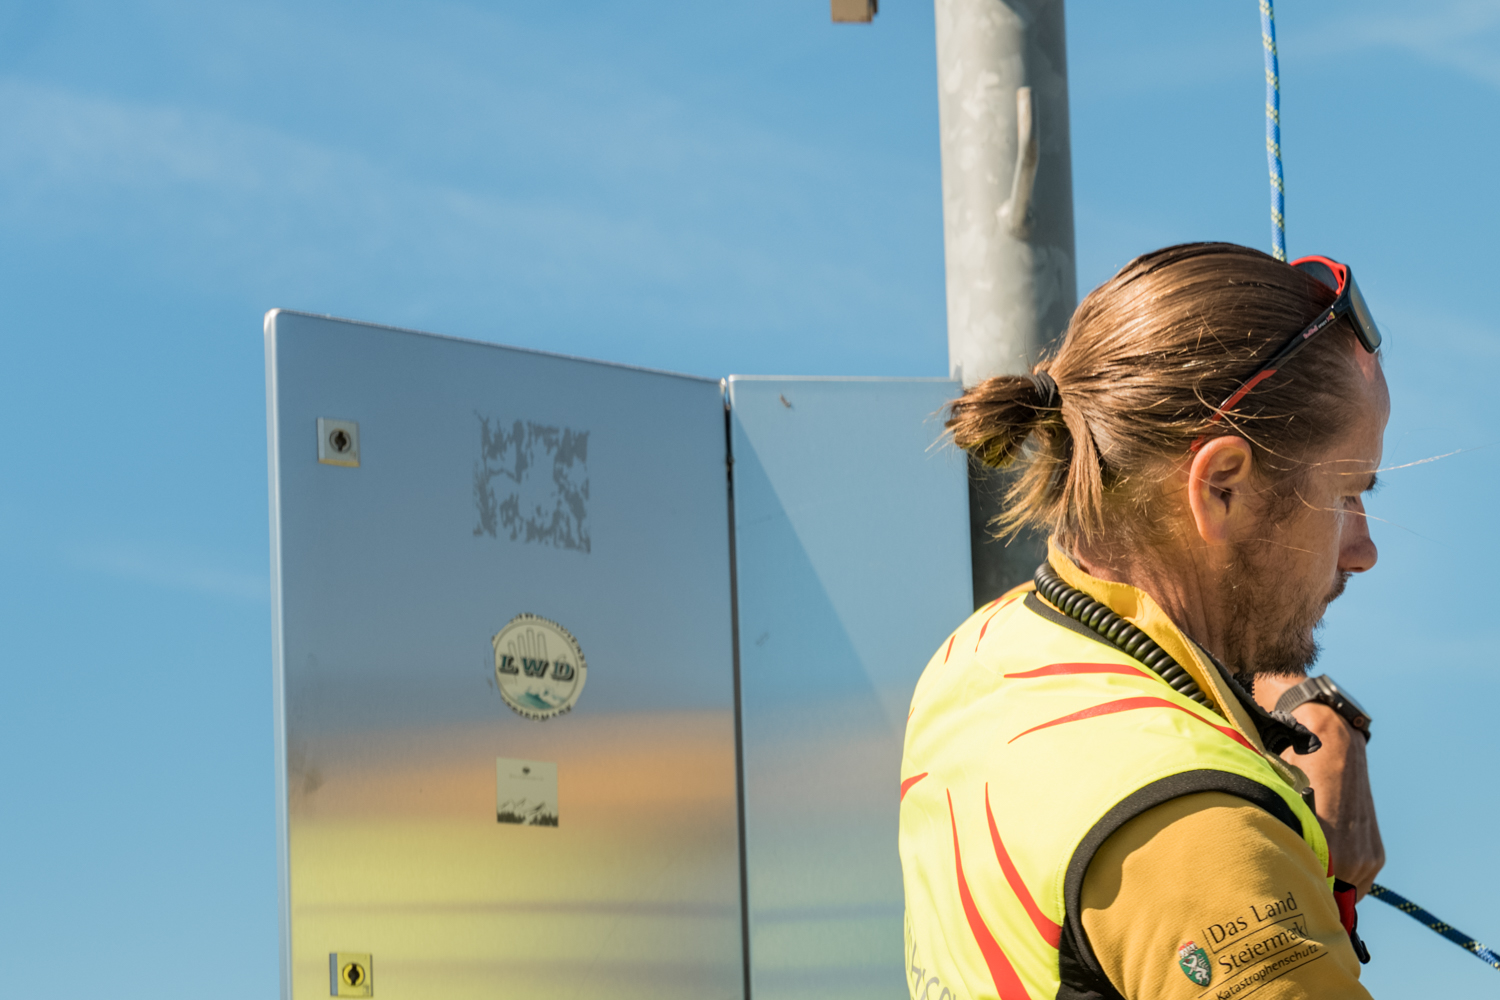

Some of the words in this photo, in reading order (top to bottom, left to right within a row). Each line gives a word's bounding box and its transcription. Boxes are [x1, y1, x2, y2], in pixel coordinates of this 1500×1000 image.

[498, 654, 575, 682] LWD
[1208, 916, 1248, 944] Das
[1250, 891, 1298, 923] Land
[1218, 921, 1308, 975] Steiermark
